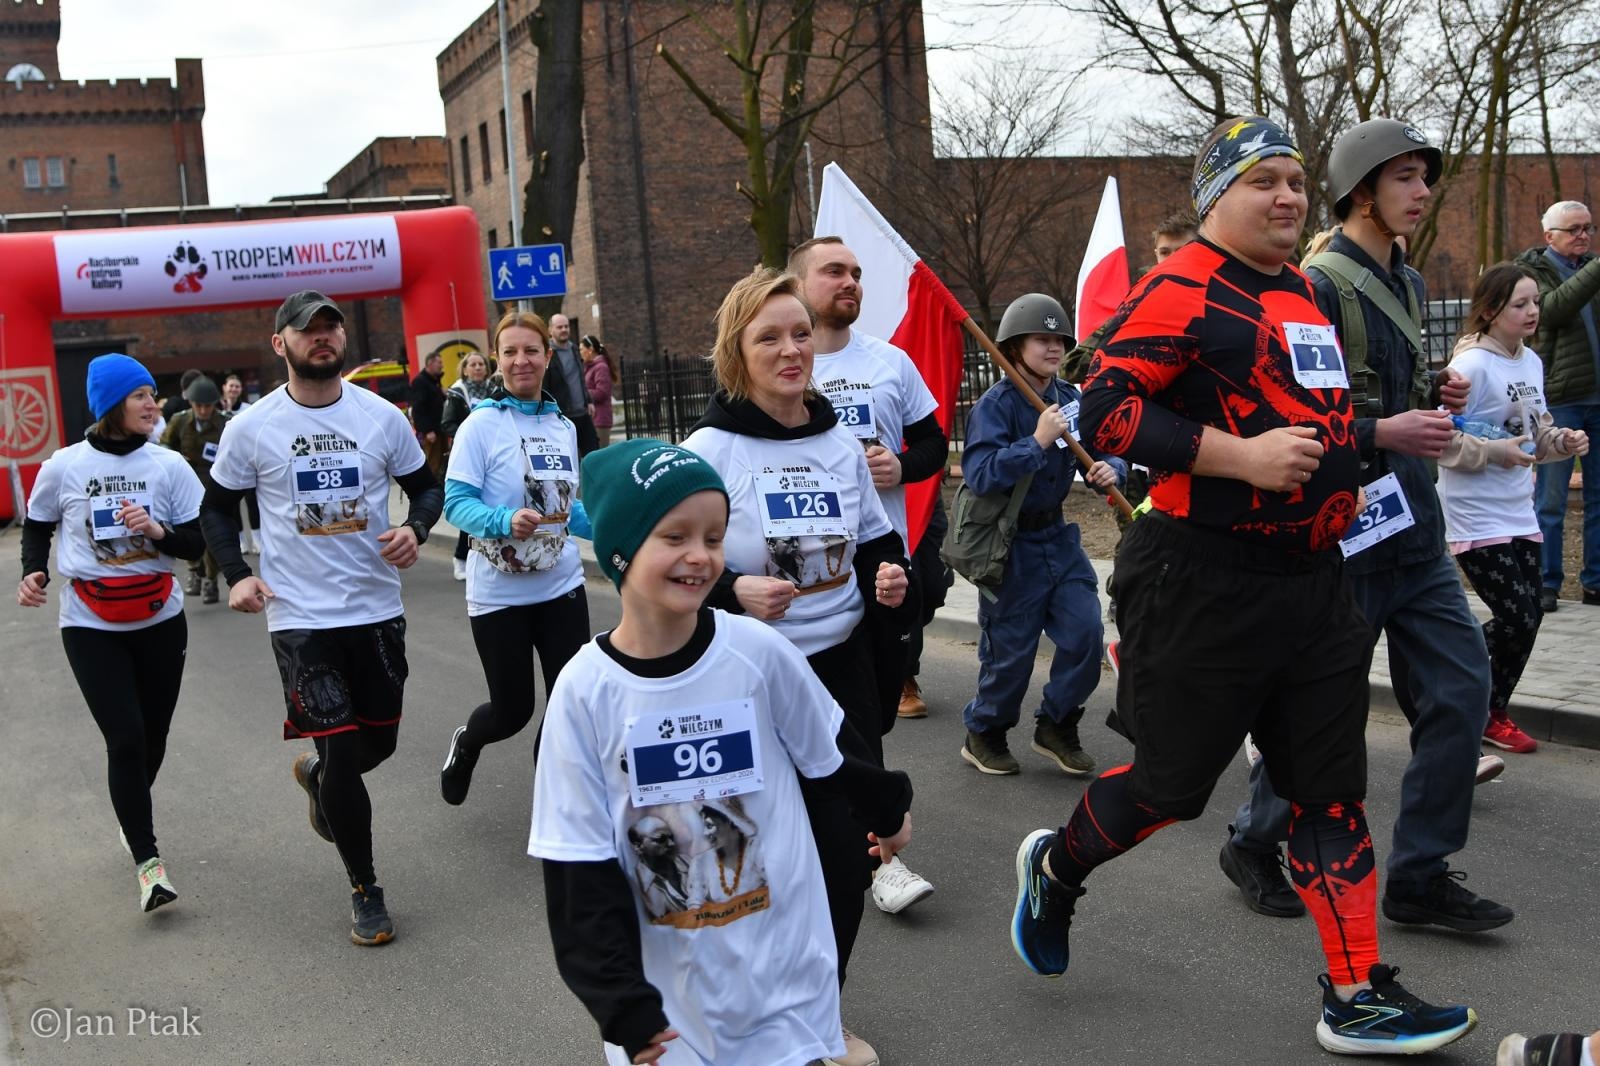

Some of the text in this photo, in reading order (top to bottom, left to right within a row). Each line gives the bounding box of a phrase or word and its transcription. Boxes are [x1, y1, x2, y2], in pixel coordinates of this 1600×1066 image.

[212, 238, 386, 271] TROPEMWILCZYM
[1311, 346, 1326, 369] 2
[822, 378, 847, 388] TROPEM
[834, 406, 860, 425] 28
[312, 433, 336, 441] TROPEM
[314, 440, 358, 452] WILCZYM
[544, 455, 563, 470] 95
[317, 469, 343, 489] 98
[643, 457, 700, 490] SWIM TEAM
[104, 480, 147, 493] WILCZYM
[792, 480, 820, 488] WILCZYM
[784, 493, 829, 517] 126
[111, 509, 125, 525] 9
[1358, 502, 1388, 531] 52
[678, 714, 701, 723] TROPEM
[680, 718, 723, 735] WILCZYM
[673, 739, 723, 777] 96
